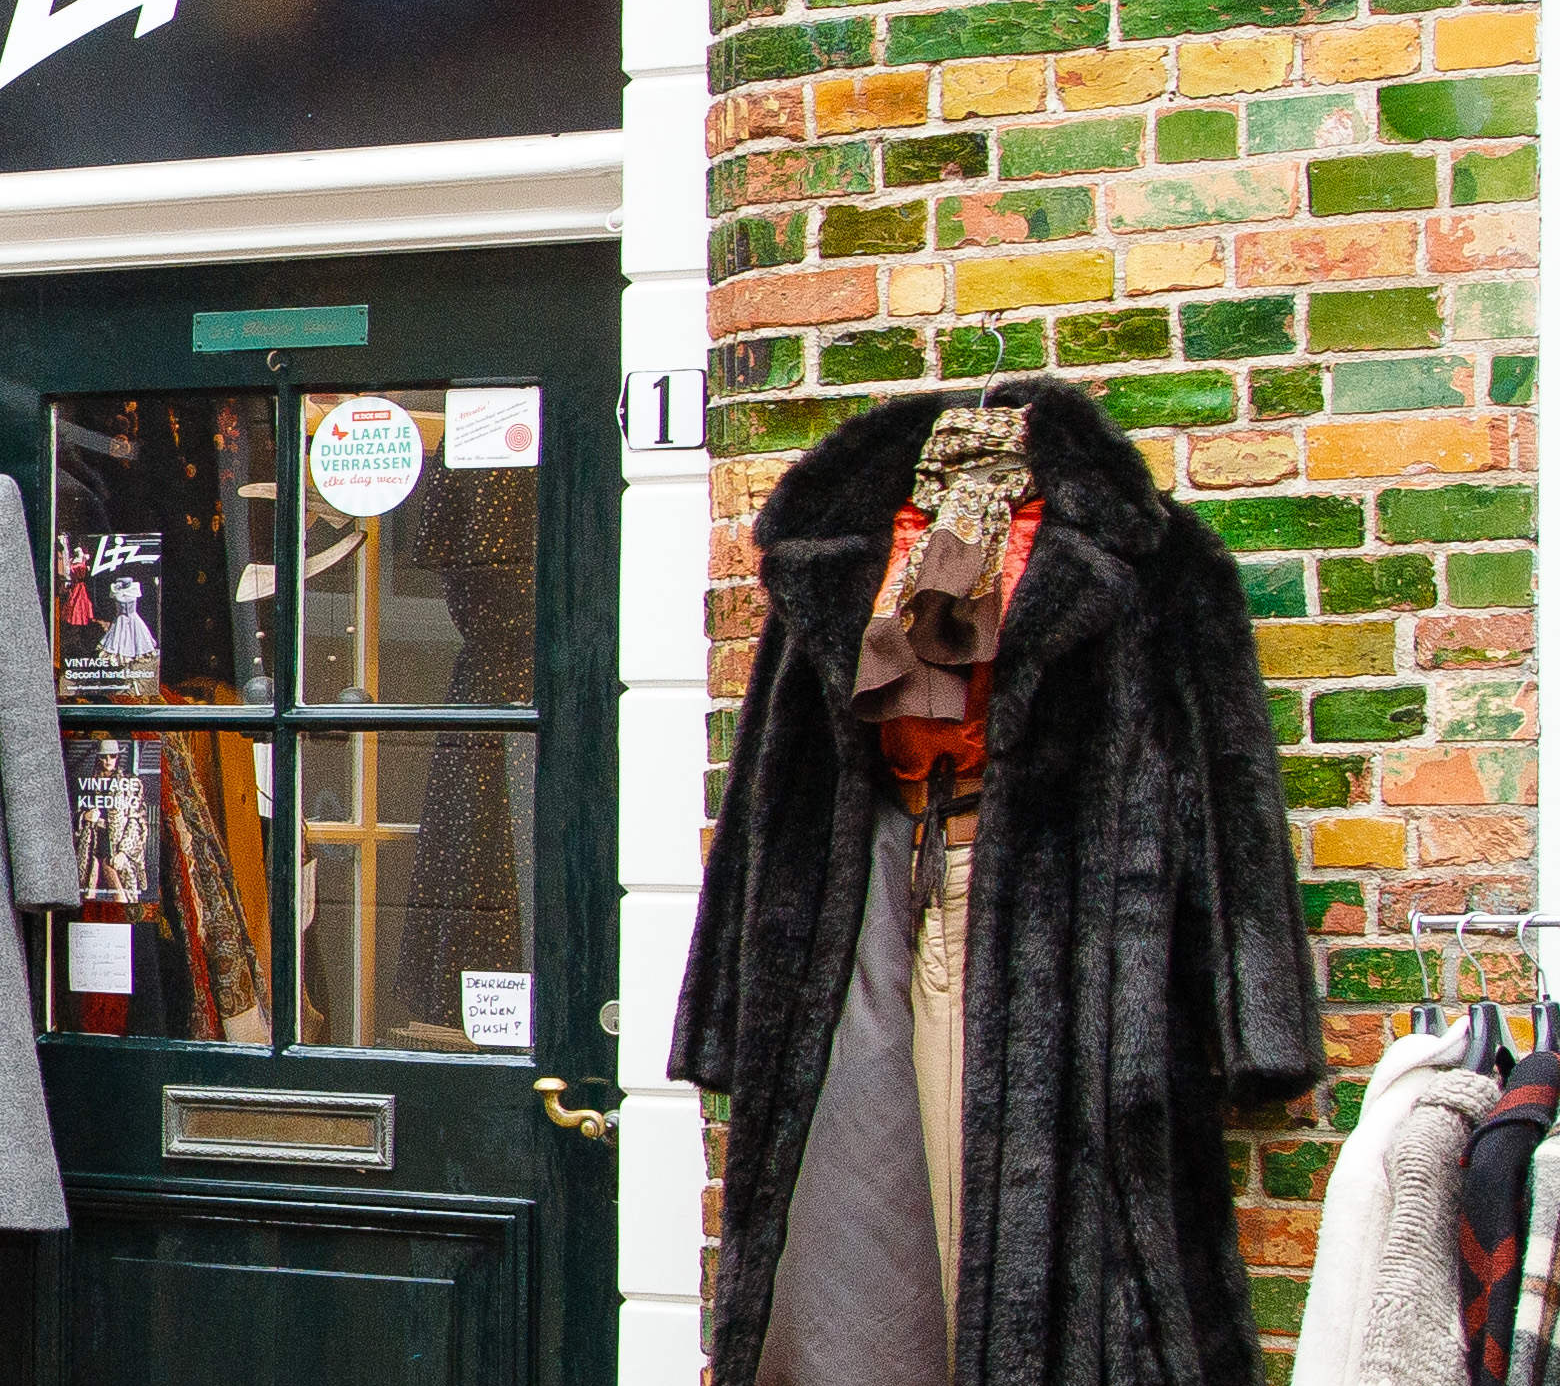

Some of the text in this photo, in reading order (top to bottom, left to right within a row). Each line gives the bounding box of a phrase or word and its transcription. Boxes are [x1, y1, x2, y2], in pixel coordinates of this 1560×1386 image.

[653, 376, 673, 444] 1
[352, 427, 410, 440] LAAT JE
[321, 442, 411, 456] DUURZAAM
[321, 457, 411, 471] VERRASSEN
[323, 476, 346, 488] elke
[350, 474, 371, 486] dag
[91, 536, 161, 576] Liz
[65, 658, 109, 668] VINTAGE
[65, 670, 154, 679] Second hand fashion
[78, 777, 140, 791] VINTAGE
[78, 795, 140, 809] KLEDING
